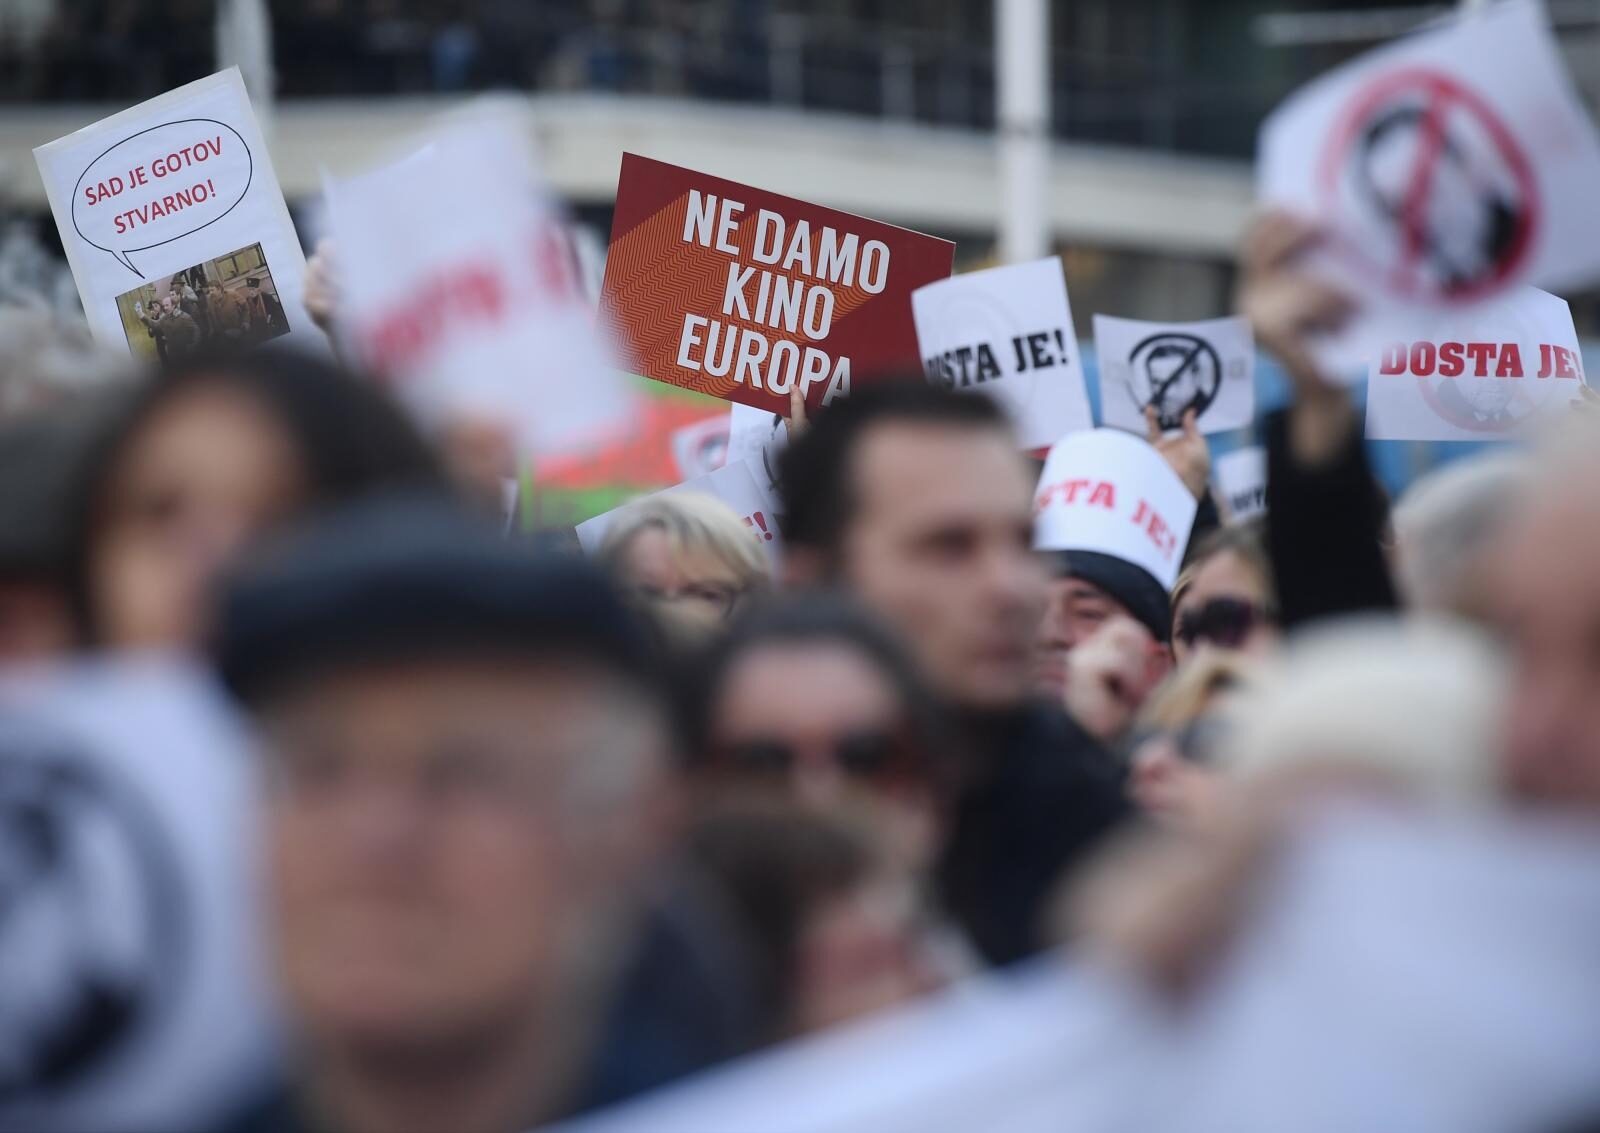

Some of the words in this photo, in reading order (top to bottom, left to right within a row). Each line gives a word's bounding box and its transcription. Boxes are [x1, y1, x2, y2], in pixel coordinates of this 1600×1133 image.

[85, 176, 124, 206] SAD
[129, 165, 148, 190] JE
[151, 136, 222, 178] GOTOV
[113, 179, 217, 234] STVARNO!
[682, 188, 746, 256] NE
[752, 208, 891, 294] DAMO
[722, 261, 835, 341] KINO
[676, 313, 851, 408] EUROPA
[1012, 329, 1067, 373] JE!
[1379, 340, 1524, 378] DOSTA
